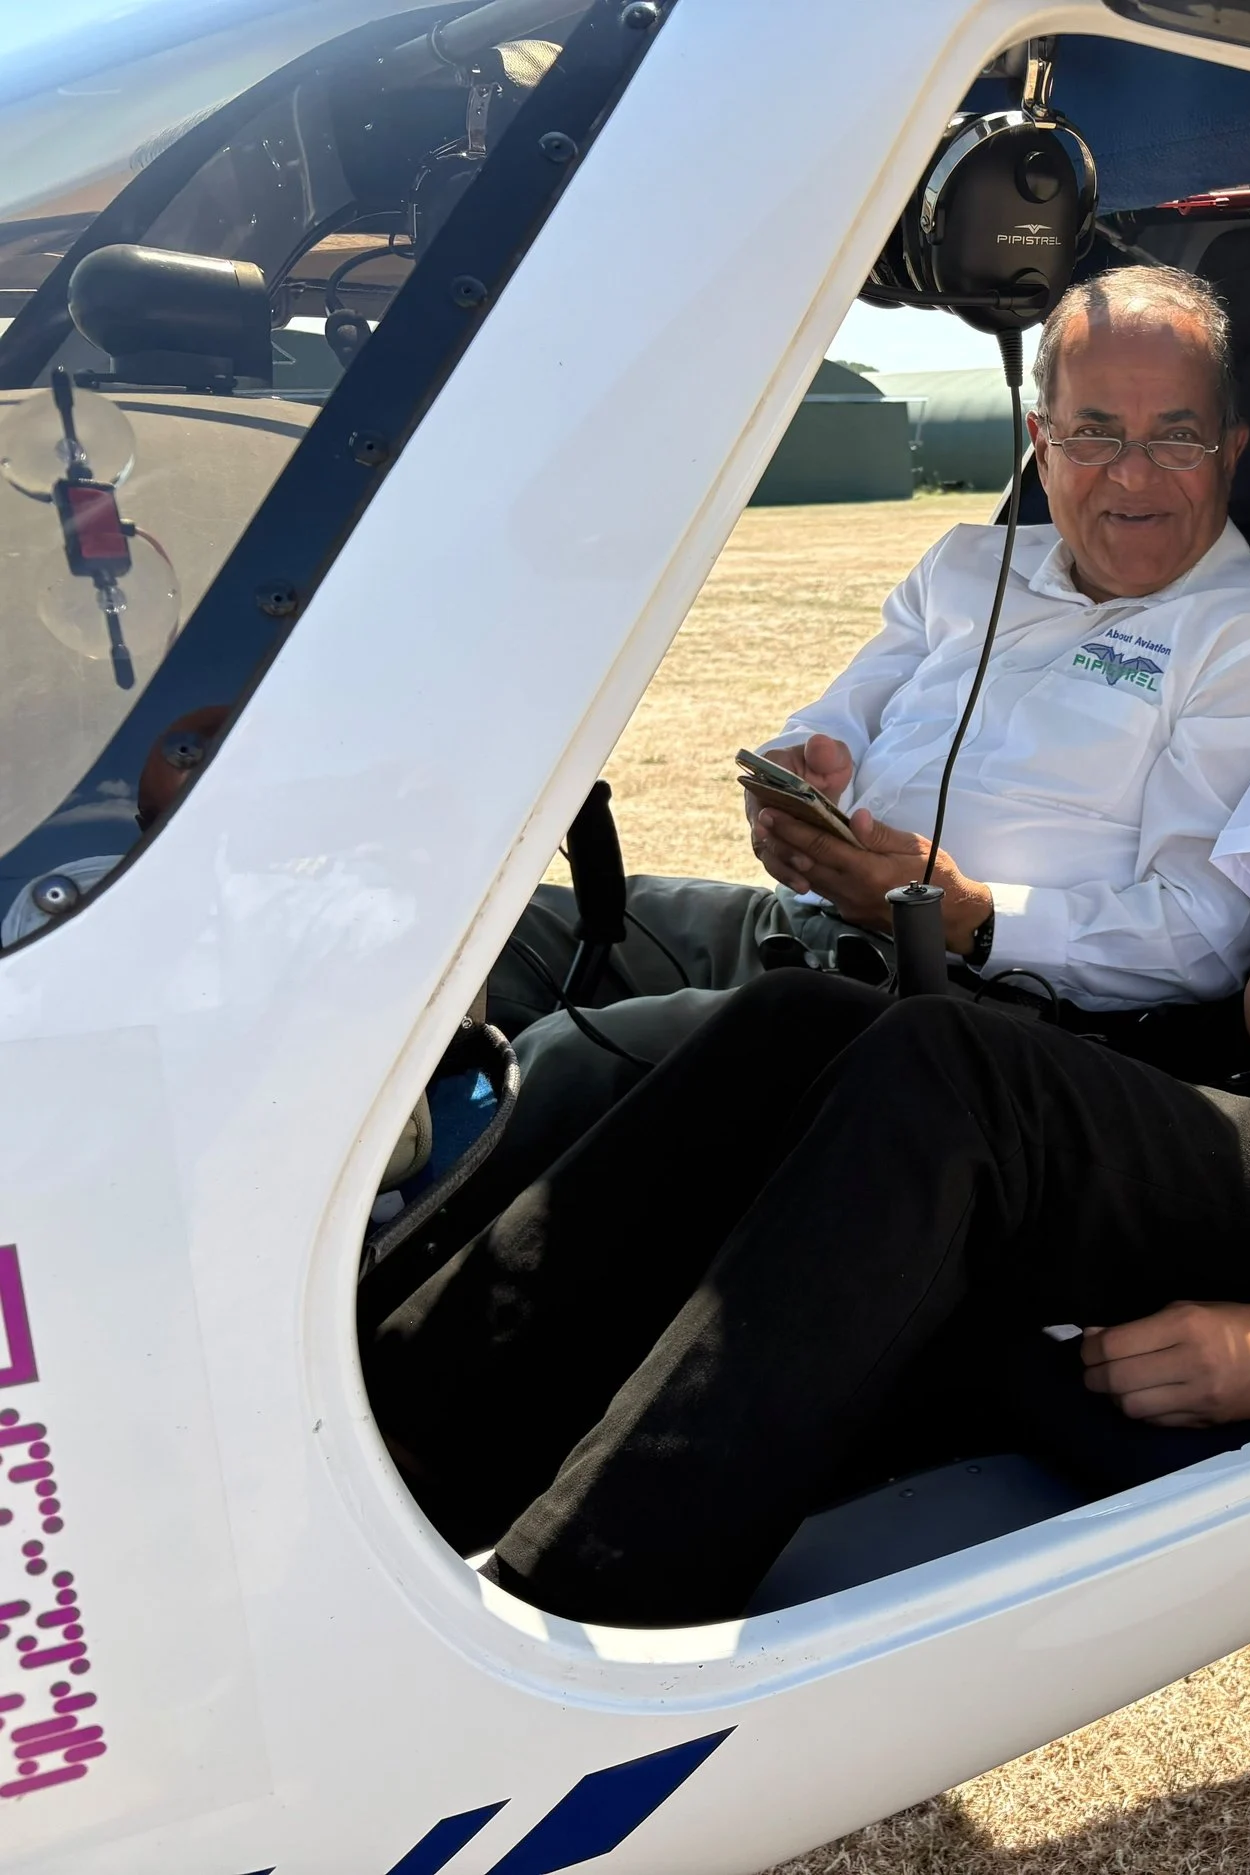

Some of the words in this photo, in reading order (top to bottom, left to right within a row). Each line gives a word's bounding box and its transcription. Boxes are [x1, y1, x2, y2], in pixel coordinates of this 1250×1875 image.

[996, 234, 1062, 246] PIPISTREL
[1105, 629, 1133, 643] About
[1134, 636, 1172, 656] Aviation
